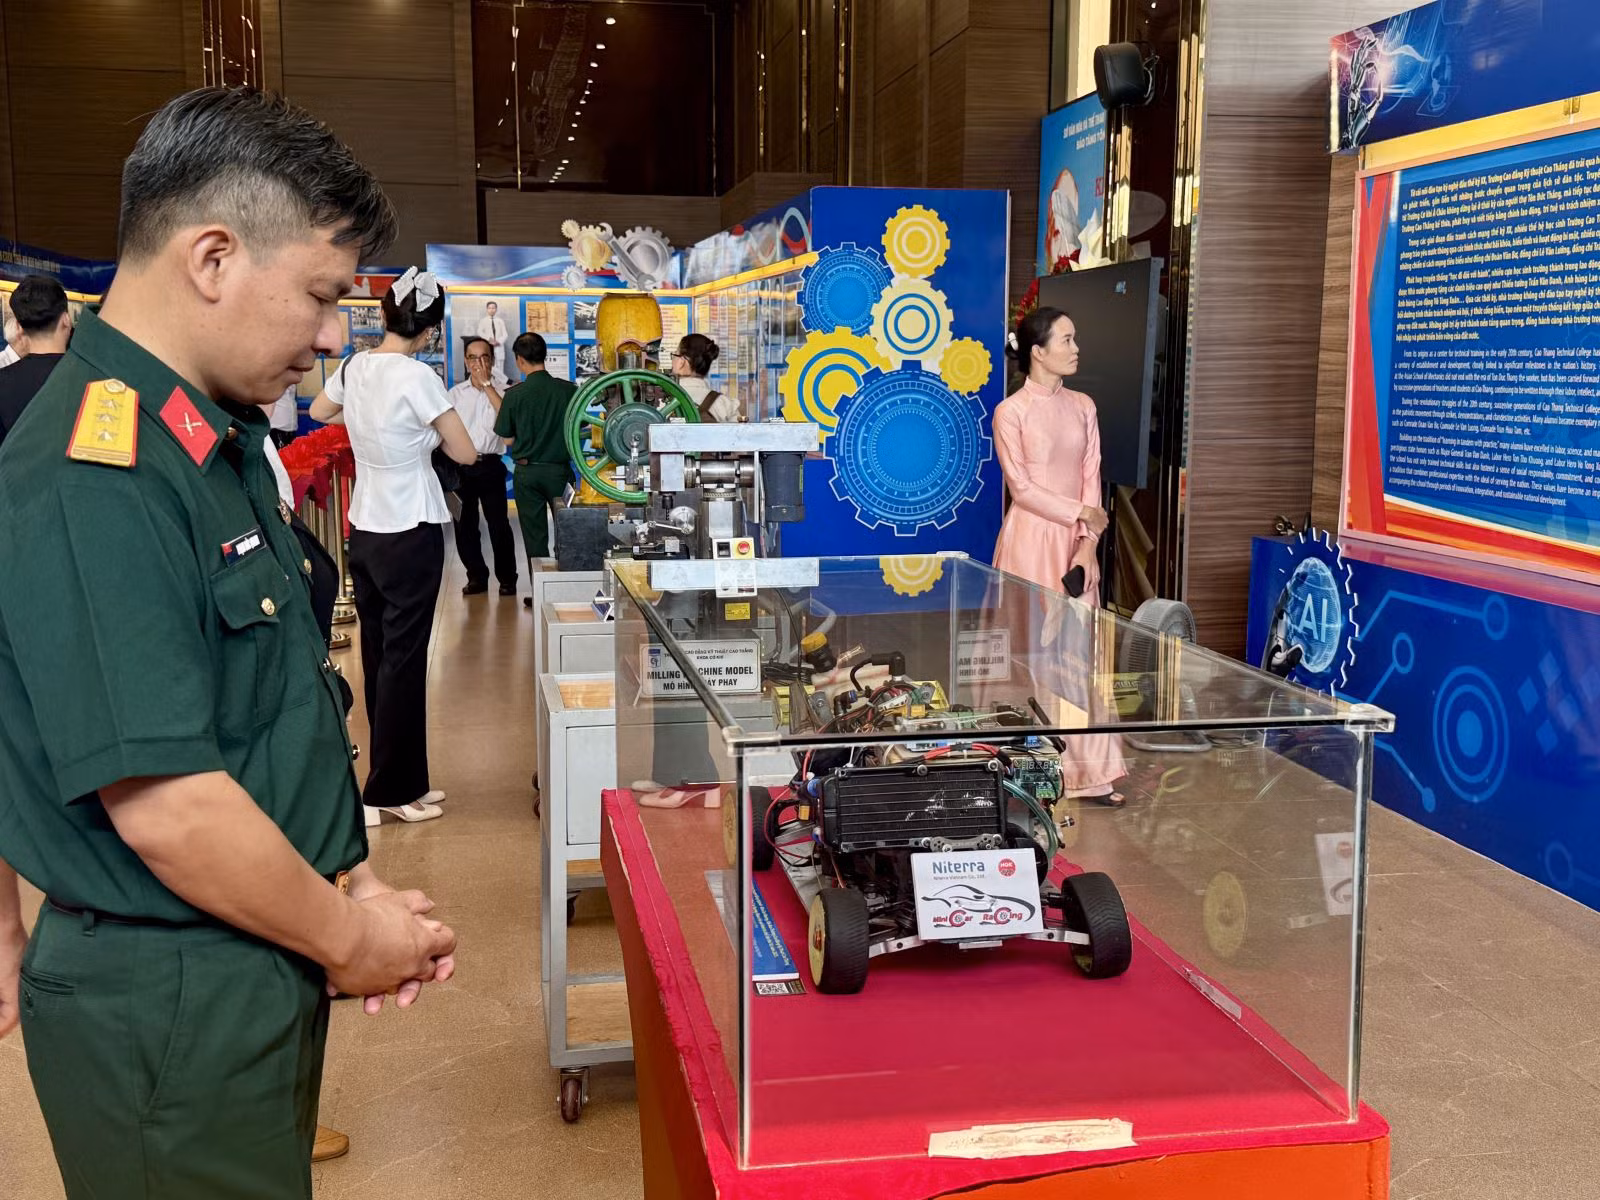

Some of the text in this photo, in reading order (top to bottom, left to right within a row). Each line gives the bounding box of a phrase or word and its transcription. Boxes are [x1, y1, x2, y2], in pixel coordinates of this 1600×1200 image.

[1298, 593, 1328, 643] AI
[647, 666, 753, 680] MILLING CHINE MODEL
[678, 681, 694, 690] HÌN
[718, 679, 738, 687] PHAY
[932, 861, 985, 874] Niterra
